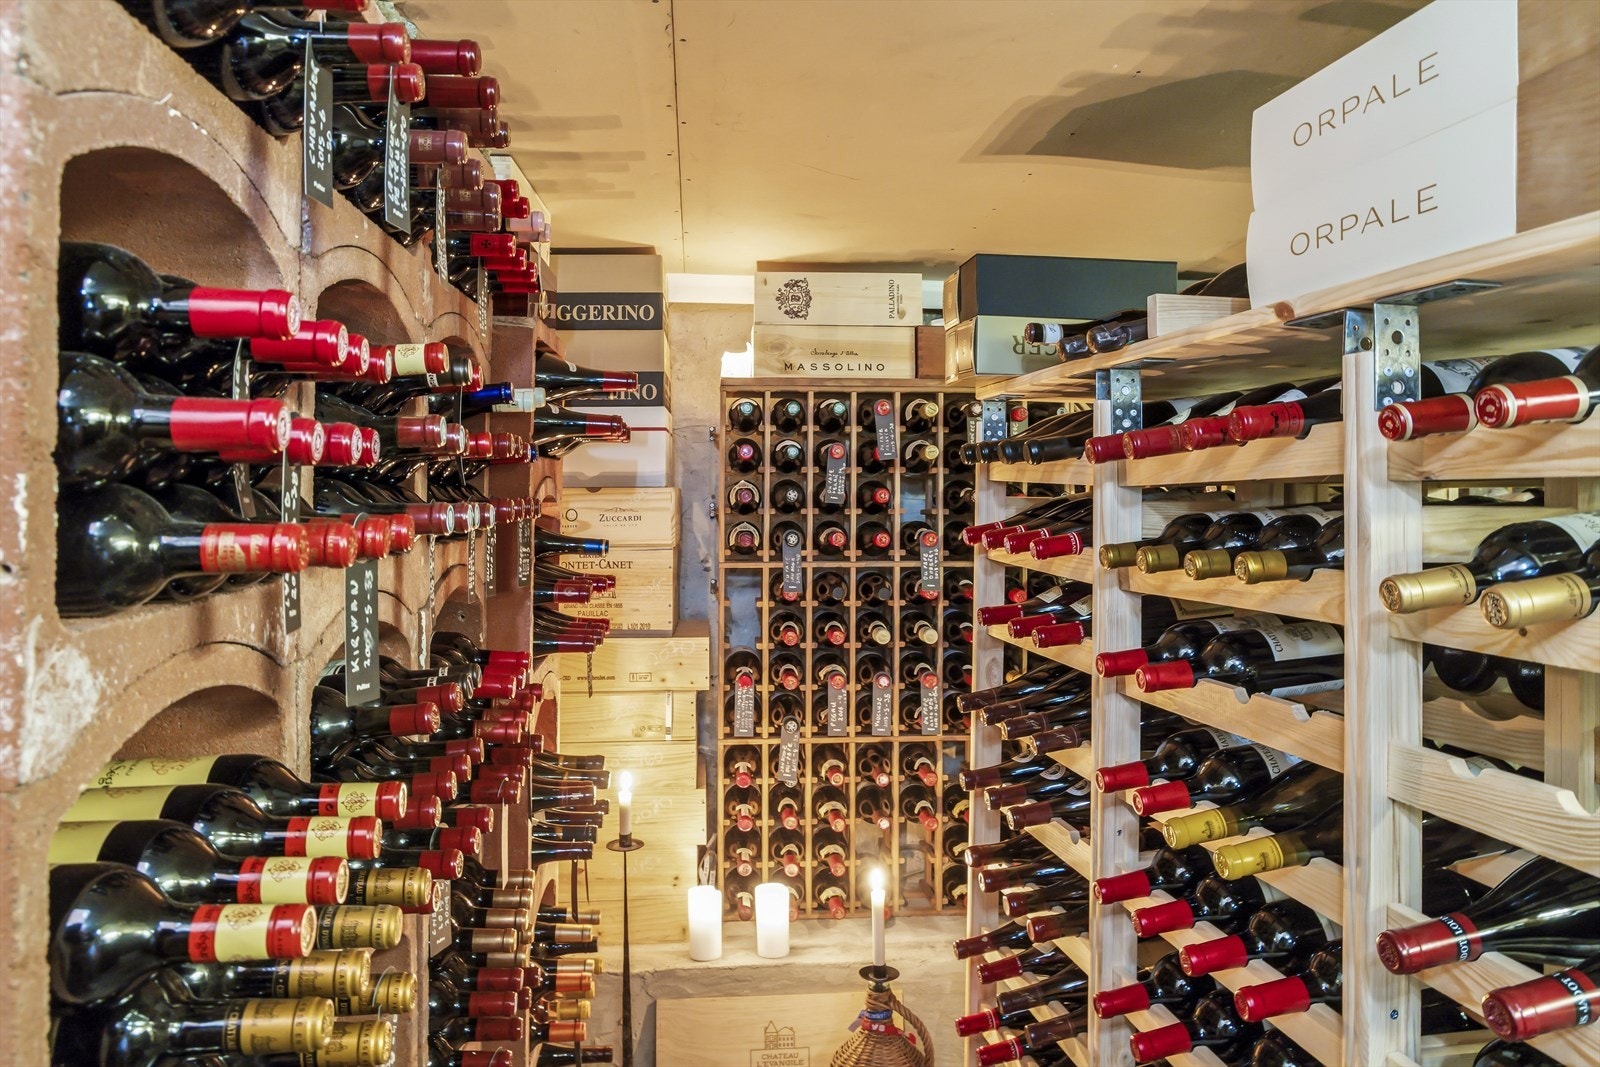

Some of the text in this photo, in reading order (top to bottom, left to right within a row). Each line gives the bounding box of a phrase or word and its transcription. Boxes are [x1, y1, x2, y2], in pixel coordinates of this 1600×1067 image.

[1293, 51, 1440, 147] ORPALE
[1290, 183, 1439, 256] ORPALE
[784, 362, 886, 371] MASSOLINO
[350, 579, 360, 673] KIRWAN
[761, 1052, 800, 1060] CHATEAU
